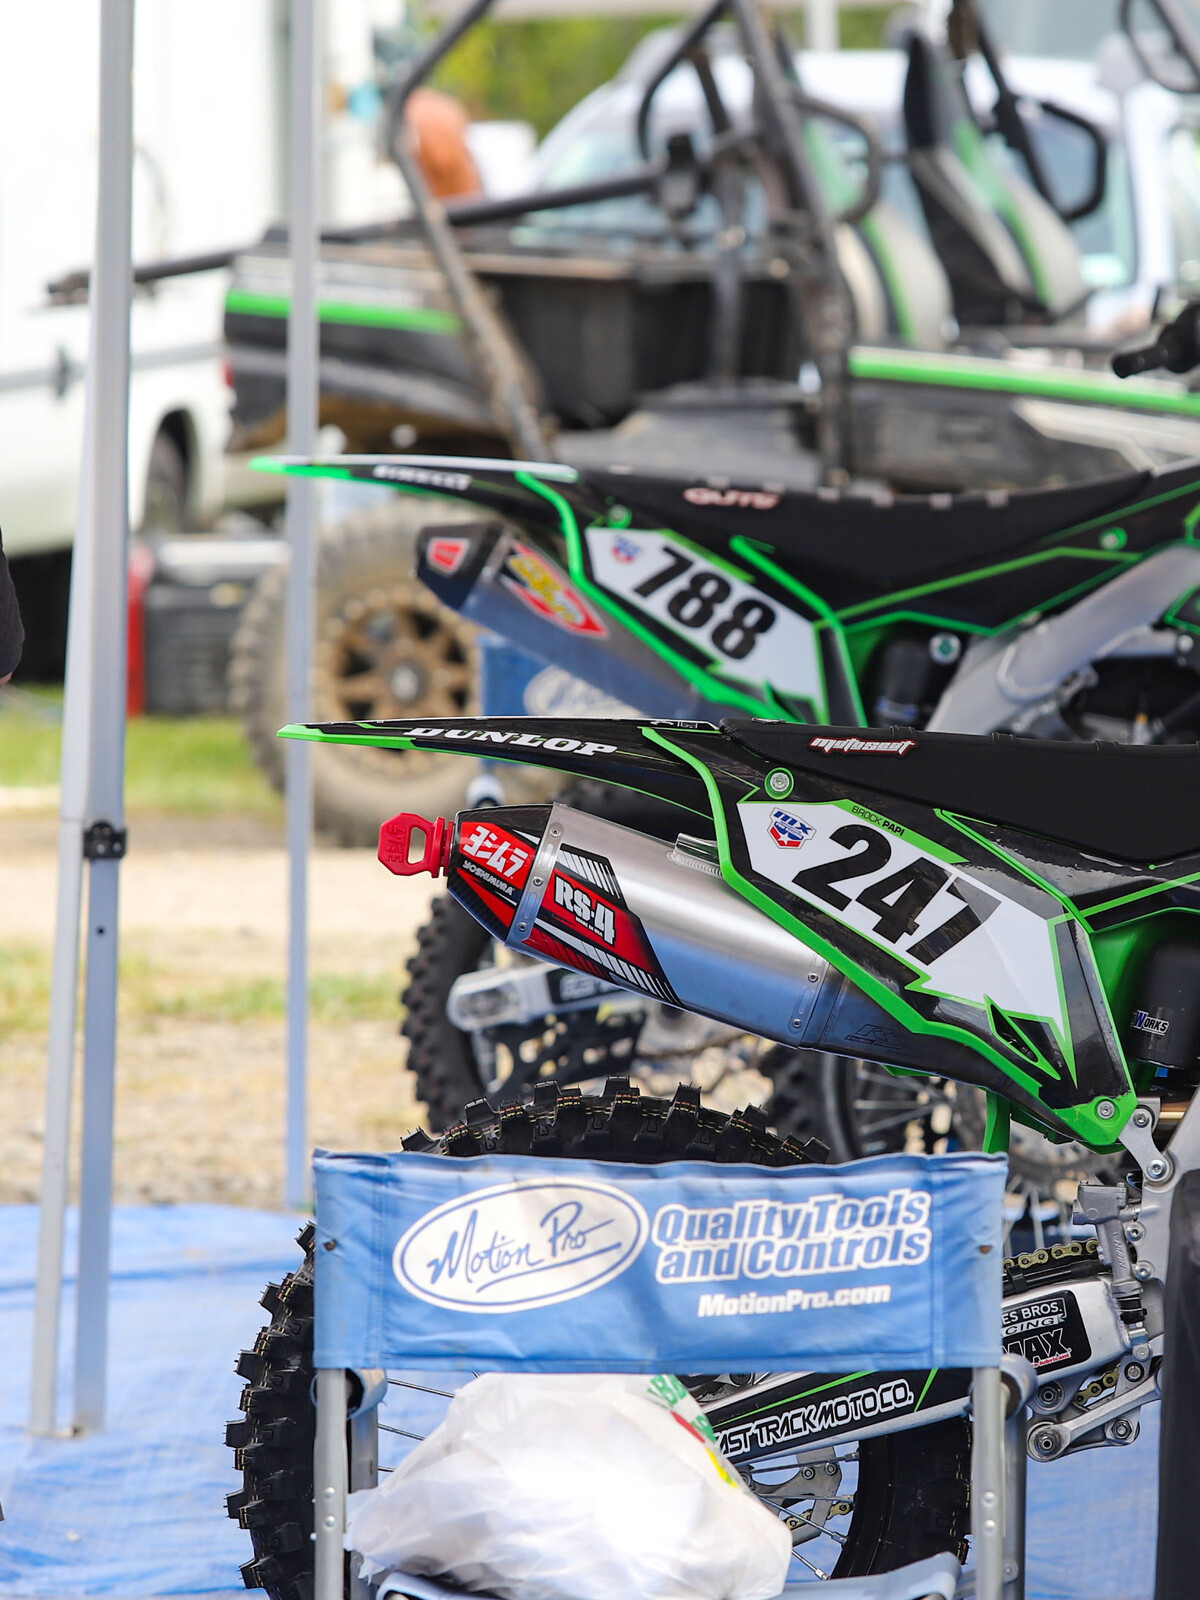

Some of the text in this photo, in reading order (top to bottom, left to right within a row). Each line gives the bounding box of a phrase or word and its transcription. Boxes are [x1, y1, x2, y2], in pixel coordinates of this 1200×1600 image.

[633, 545, 776, 660] 788
[403, 727, 618, 757] DUNLOP
[851, 804, 905, 838] BROCK PAPI
[462, 860, 515, 896] YOSHIMURA
[791, 823, 982, 968] 247
[1135, 1010, 1169, 1034] WORKS
[654, 1192, 928, 1243] Quality Tools
[426, 1201, 614, 1284] Motion Pro
[655, 1227, 931, 1282] and Controls
[698, 1285, 891, 1318] MotionPro.com
[1021, 1302, 1063, 1319] BROS.
[1005, 1318, 1055, 1334] CING
[753, 1406, 816, 1446] TRACK
[814, 1389, 877, 1428] MOTO
